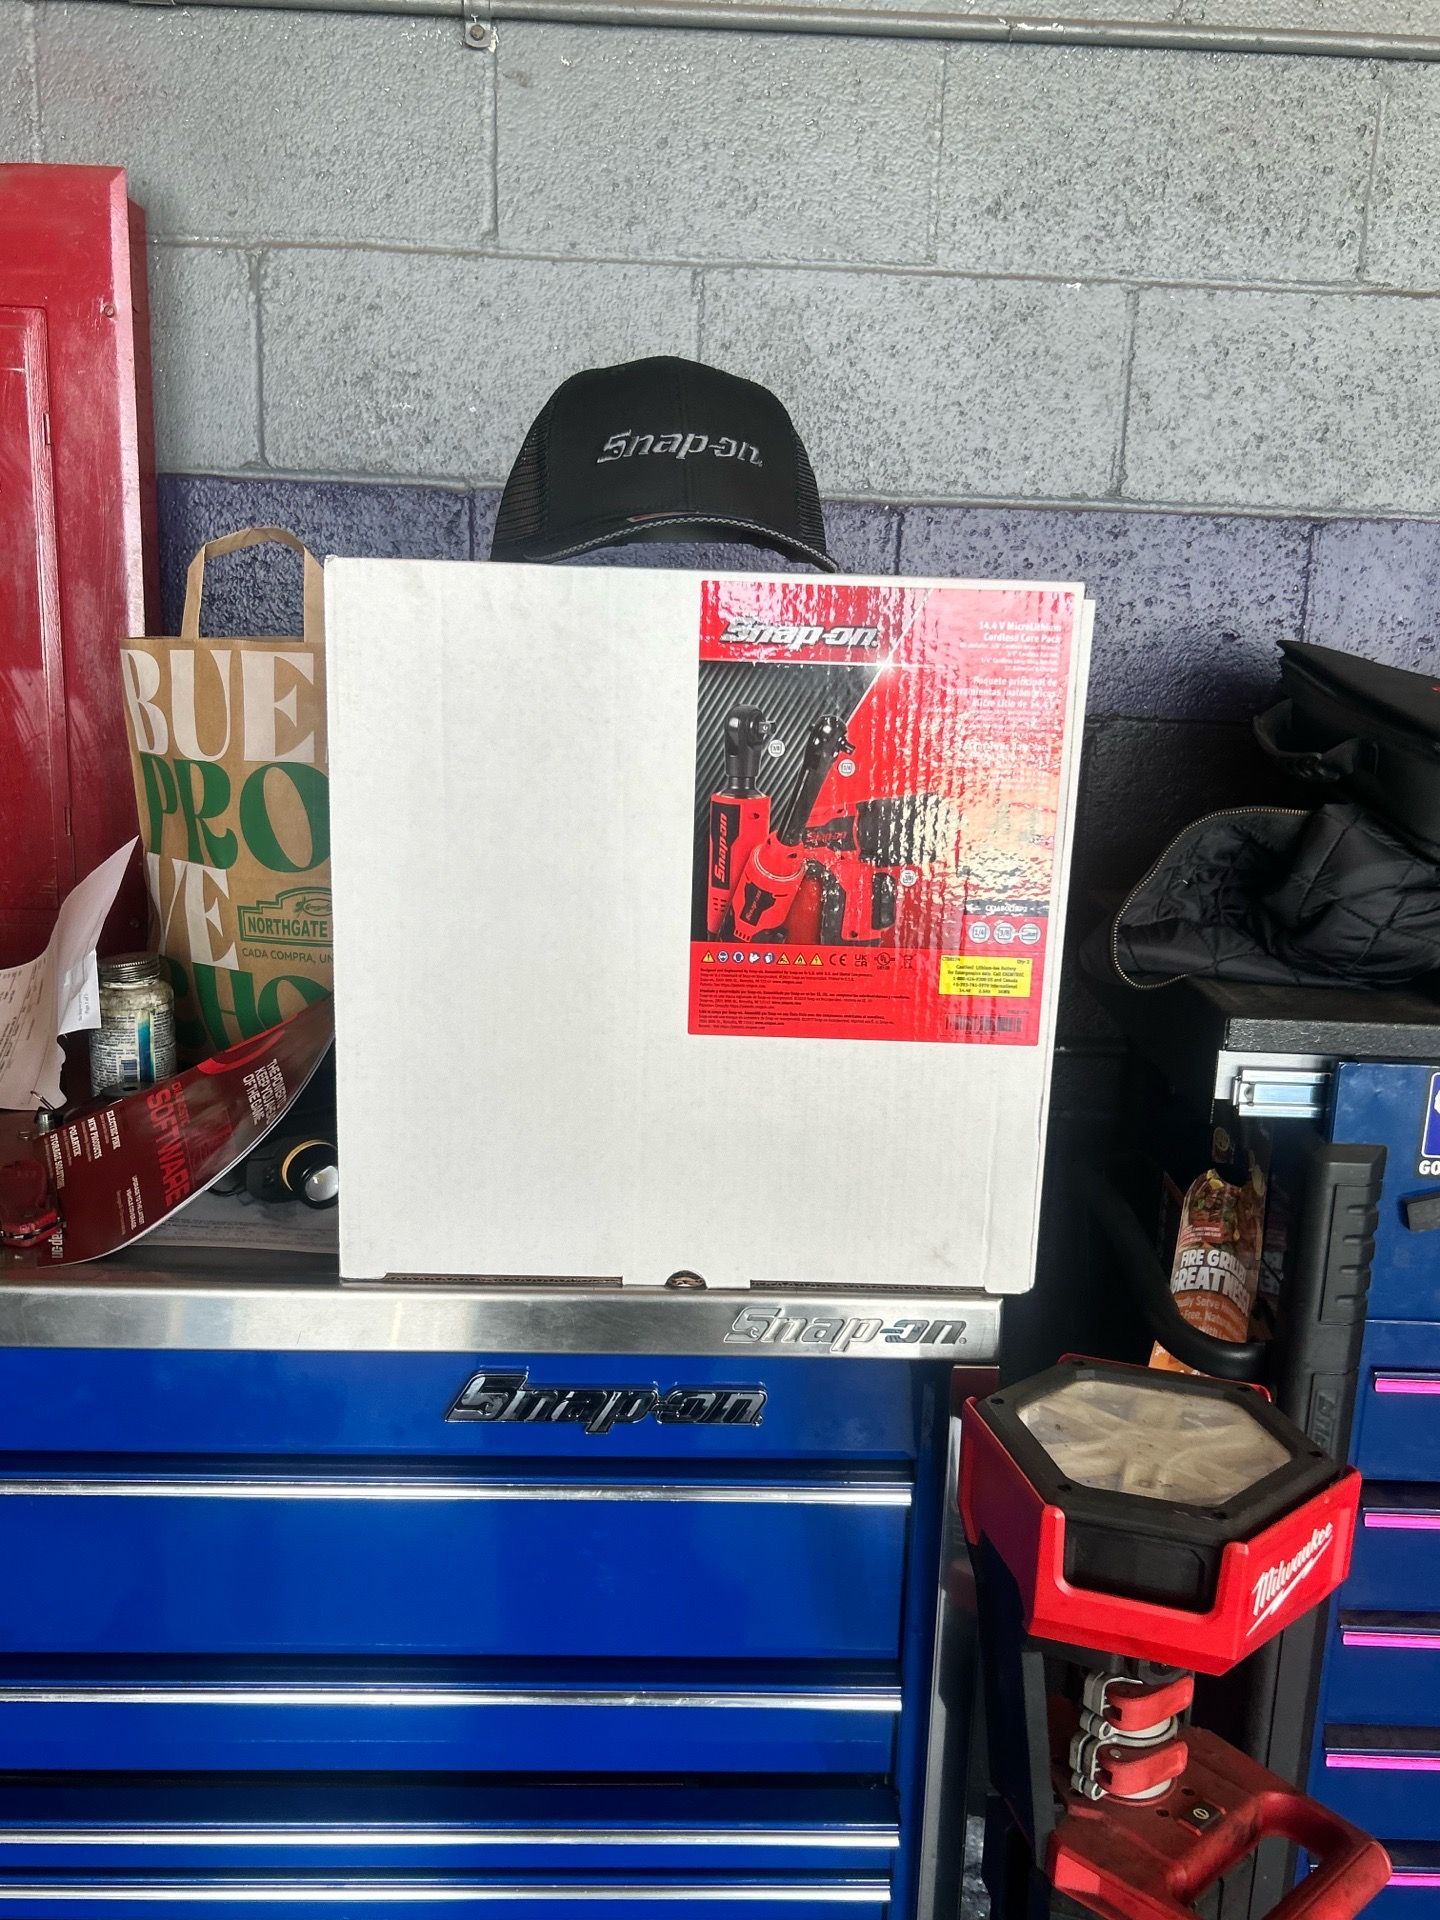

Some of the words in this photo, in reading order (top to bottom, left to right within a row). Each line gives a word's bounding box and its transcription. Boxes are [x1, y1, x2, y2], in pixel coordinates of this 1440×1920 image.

[596, 428, 764, 467] Snap-on
[718, 616, 880, 649] Snap-on
[120, 649, 328, 762] BUE
[139, 751, 331, 873] PRO
[714, 813, 729, 883] Snap-on
[242, 948, 268, 959] CADA
[248, 916, 328, 937] NORTHGATE
[147, 1087, 191, 1206] SOFTWARE
[723, 1307, 967, 1352] Snap-on
[444, 1368, 768, 1435] Snap-on
[1251, 1521, 1334, 1616] Milwaukee
